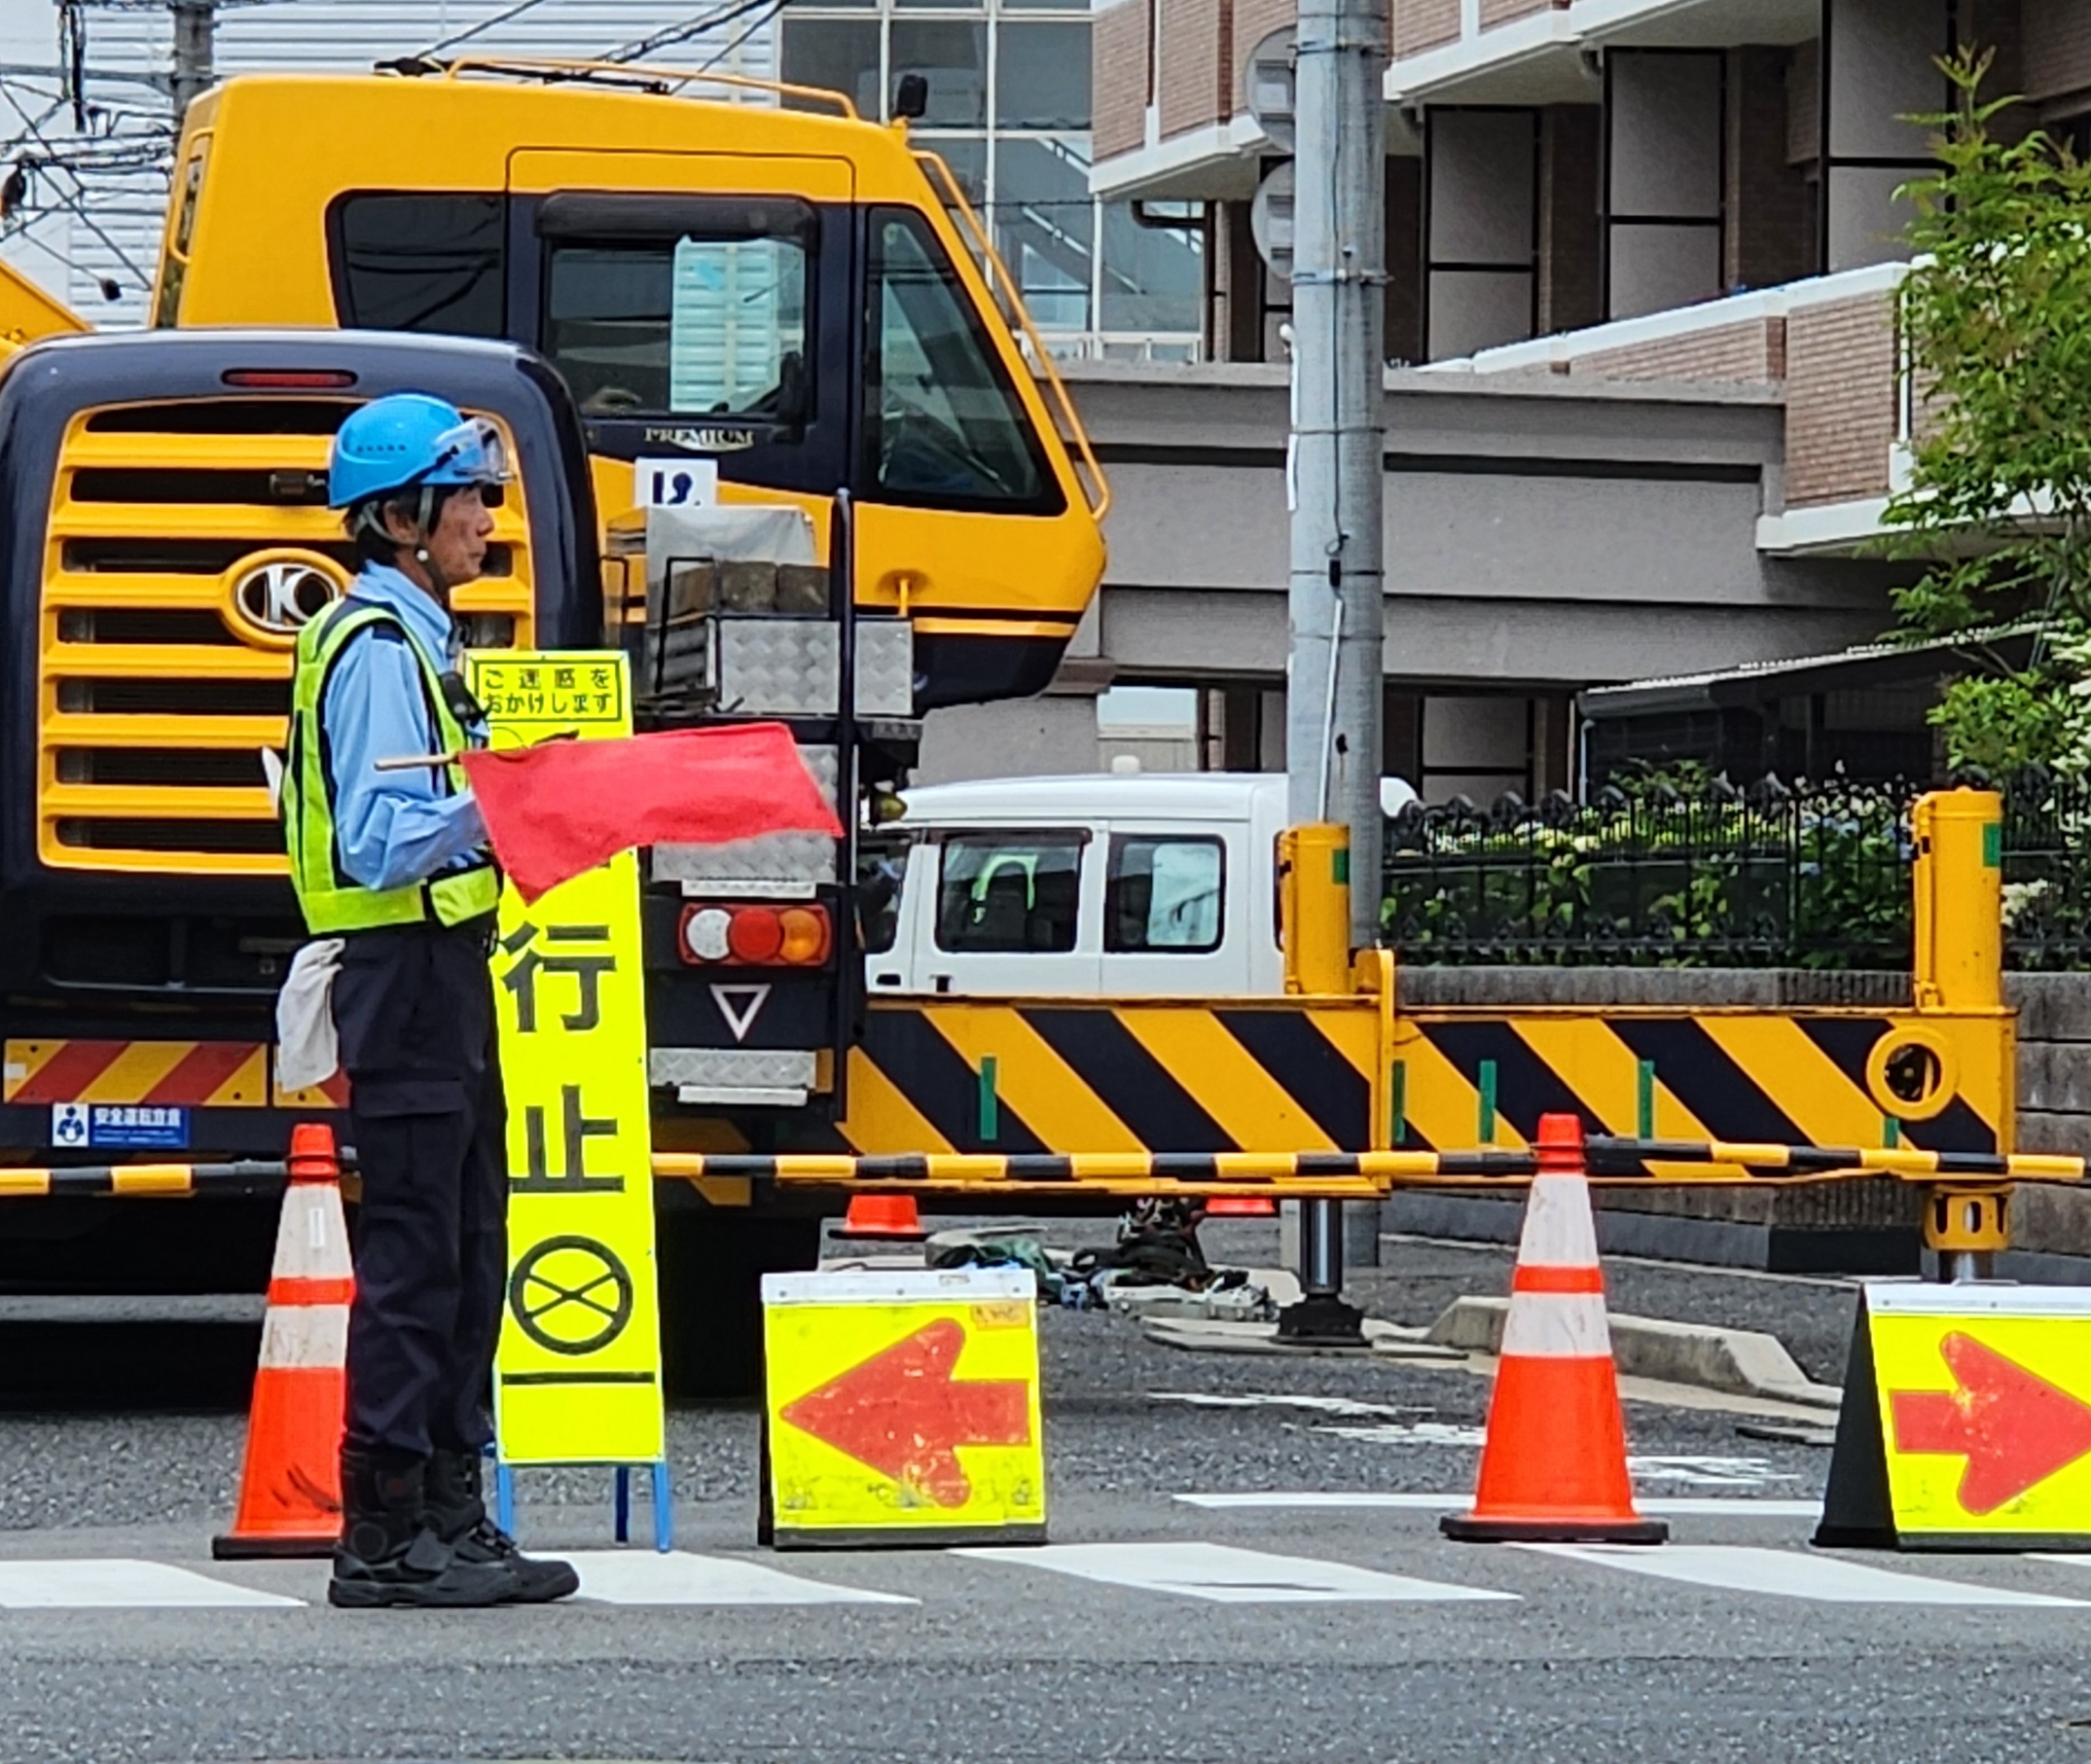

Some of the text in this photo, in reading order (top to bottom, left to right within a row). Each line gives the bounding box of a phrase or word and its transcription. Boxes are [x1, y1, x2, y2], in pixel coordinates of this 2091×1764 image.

[644, 427, 754, 449] PREMIUM
[484, 693, 612, 714] おかけします
[501, 861, 626, 1194] 行止
